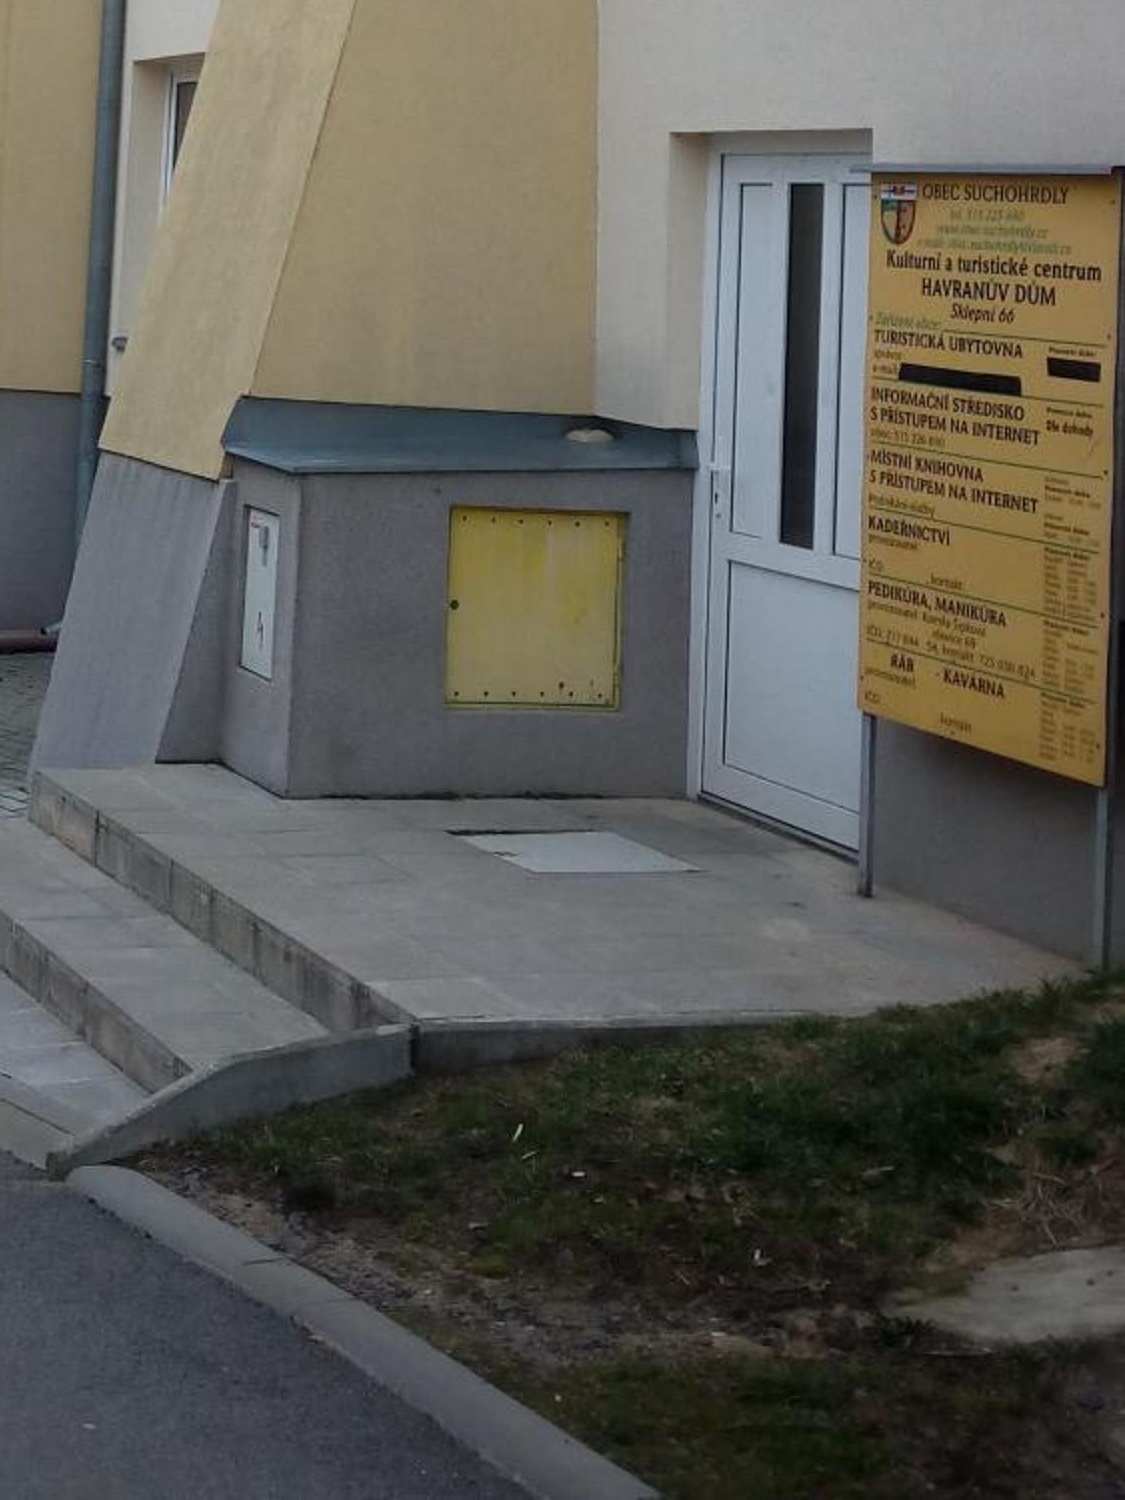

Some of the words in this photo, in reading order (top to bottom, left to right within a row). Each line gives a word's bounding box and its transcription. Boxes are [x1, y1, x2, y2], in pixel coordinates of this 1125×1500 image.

[922, 182, 960, 201] OBEC
[963, 184, 1070, 205] SUCHOHRDLY
[886, 249, 941, 271] Kulturní
[946, 258, 953, 272] a
[957, 255, 1029, 277] turistické
[1034, 261, 1102, 282] centrum
[950, 302, 995, 323] Sklepní
[998, 307, 1015, 324] 66
[874, 328, 945, 351] TURISTICKÁ
[949, 335, 1024, 359] UBYTOVNA
[873, 386, 949, 411] INFORMAČNÍ
[953, 395, 1025, 421] STŘEDISKO
[870, 406, 878, 421] S
[951, 417, 969, 436] NA
[972, 422, 1040, 446] INTERNET
[870, 448, 912, 471] MÍSTNÍ
[915, 457, 984, 483] KNIHOVNA
[868, 469, 877, 483] S
[948, 482, 967, 502] NA
[971, 487, 1039, 514] INTERNET
